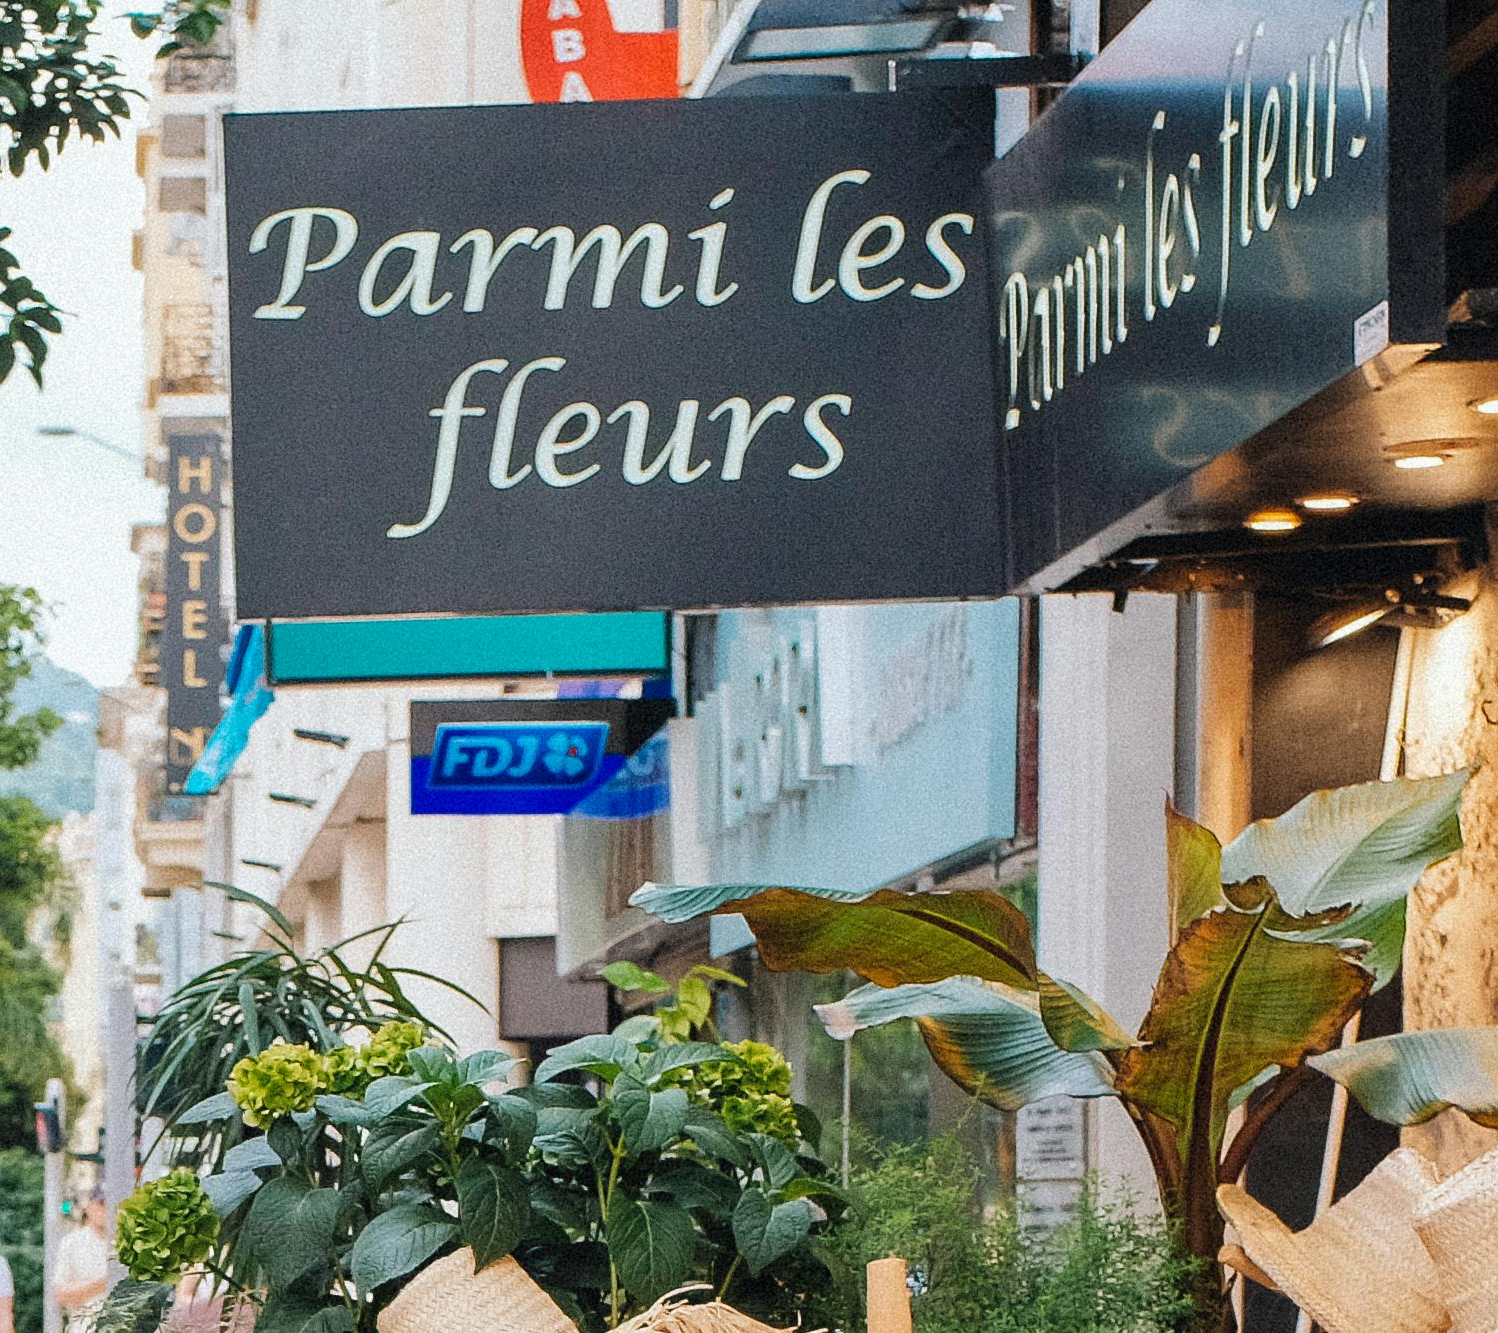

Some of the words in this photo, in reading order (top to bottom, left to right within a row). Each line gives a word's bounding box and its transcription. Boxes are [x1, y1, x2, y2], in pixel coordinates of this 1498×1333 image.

[249, 188, 739, 320] Parmi
[792, 169, 974, 306] les
[1000, 174, 1127, 431] Parmi
[1144, 110, 1202, 321] les
[1207, 0, 1376, 347] fleurs
[386, 356, 853, 541] fleurs
[173, 455, 217, 689] HOTEL
[443, 735, 539, 777] FDJ
